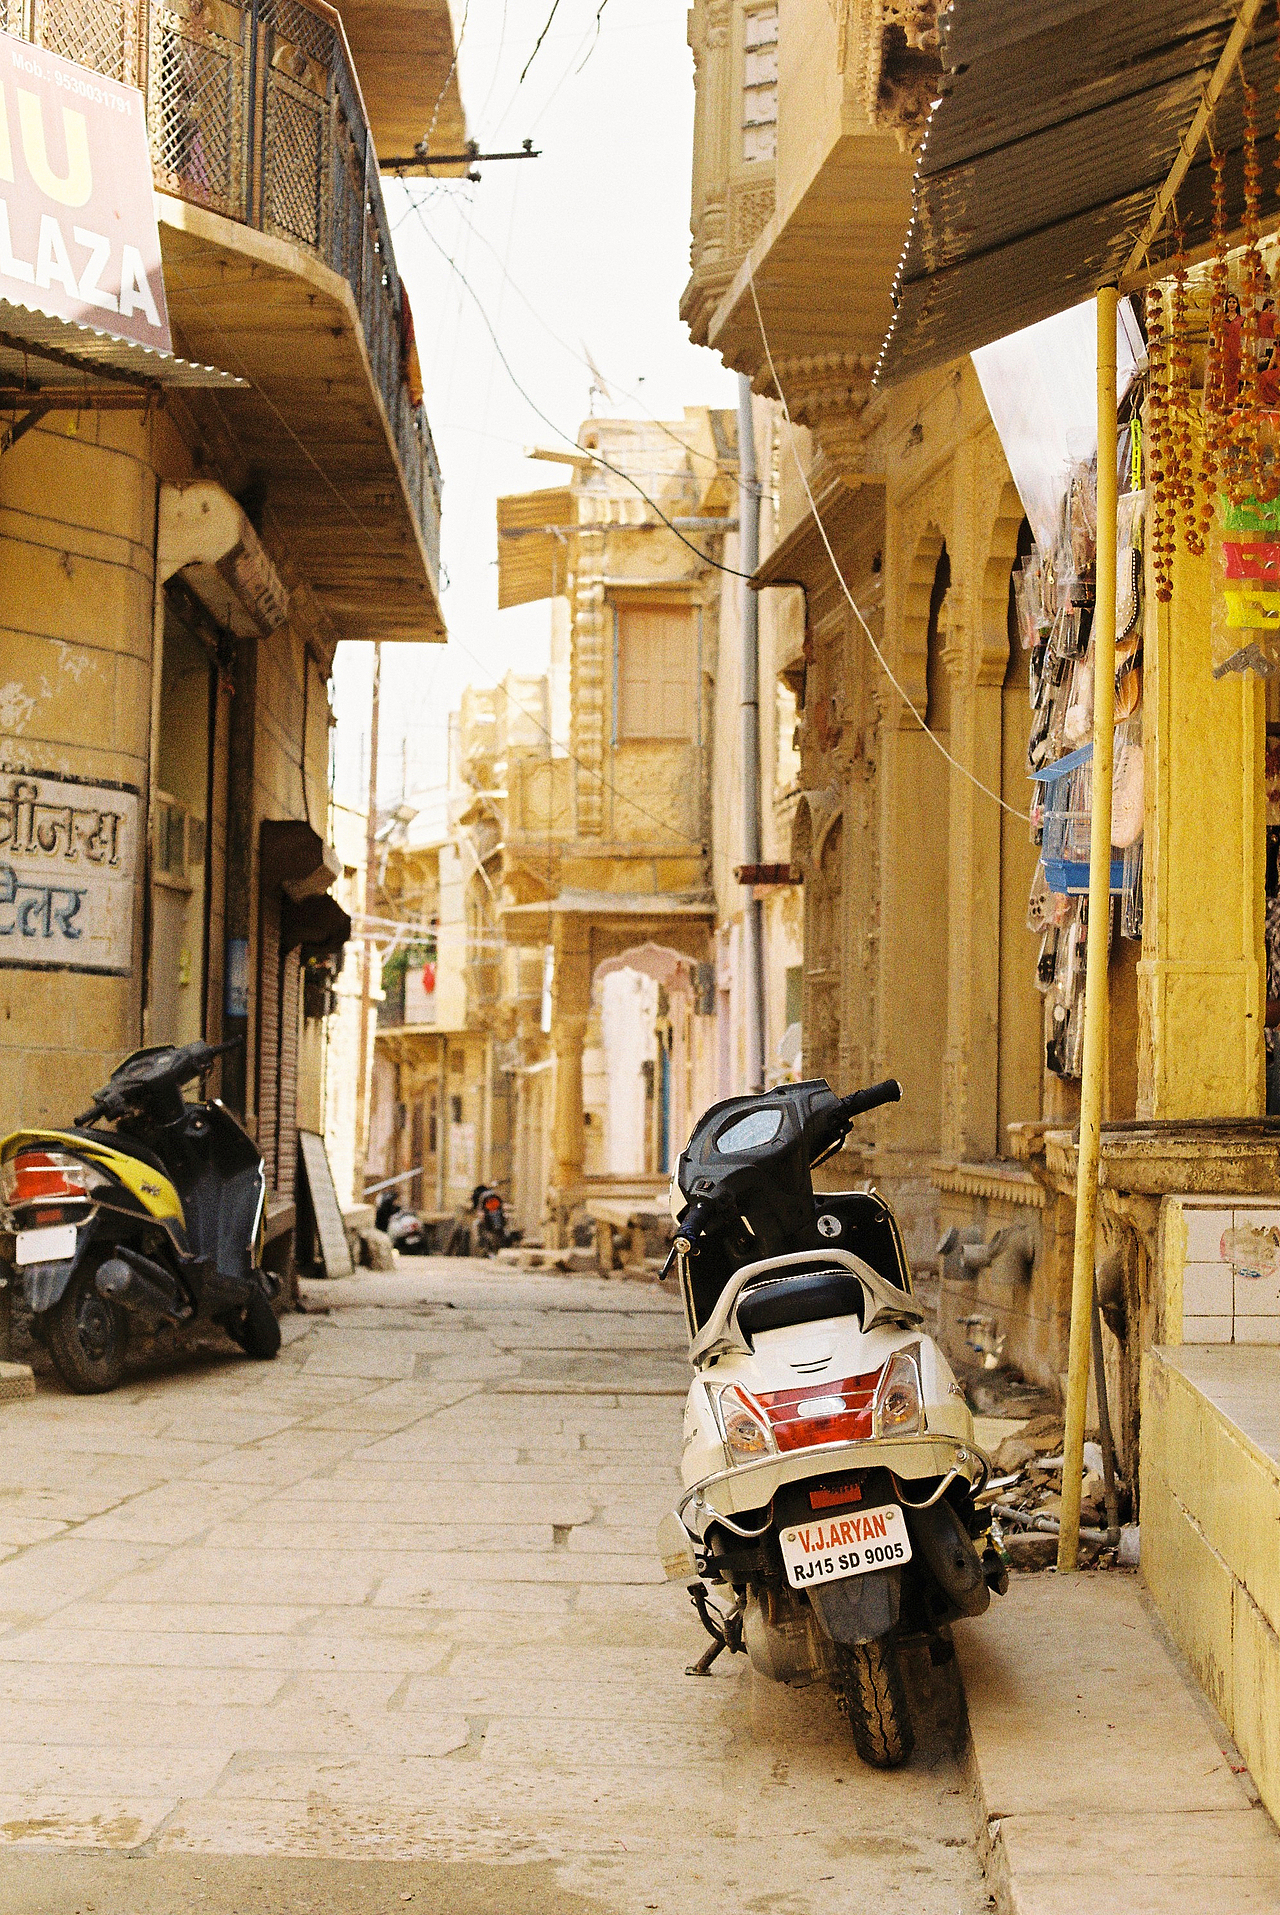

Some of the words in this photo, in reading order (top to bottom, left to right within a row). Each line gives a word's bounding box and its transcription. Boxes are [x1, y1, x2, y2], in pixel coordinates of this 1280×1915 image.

[54, 70, 132, 116] 9530031791
[798, 1513, 887, 1554] V.J.ARYAN
[793, 1557, 834, 1581] RJ15
[838, 1552, 860, 1570] SD
[864, 1542, 904, 1565] 9005
